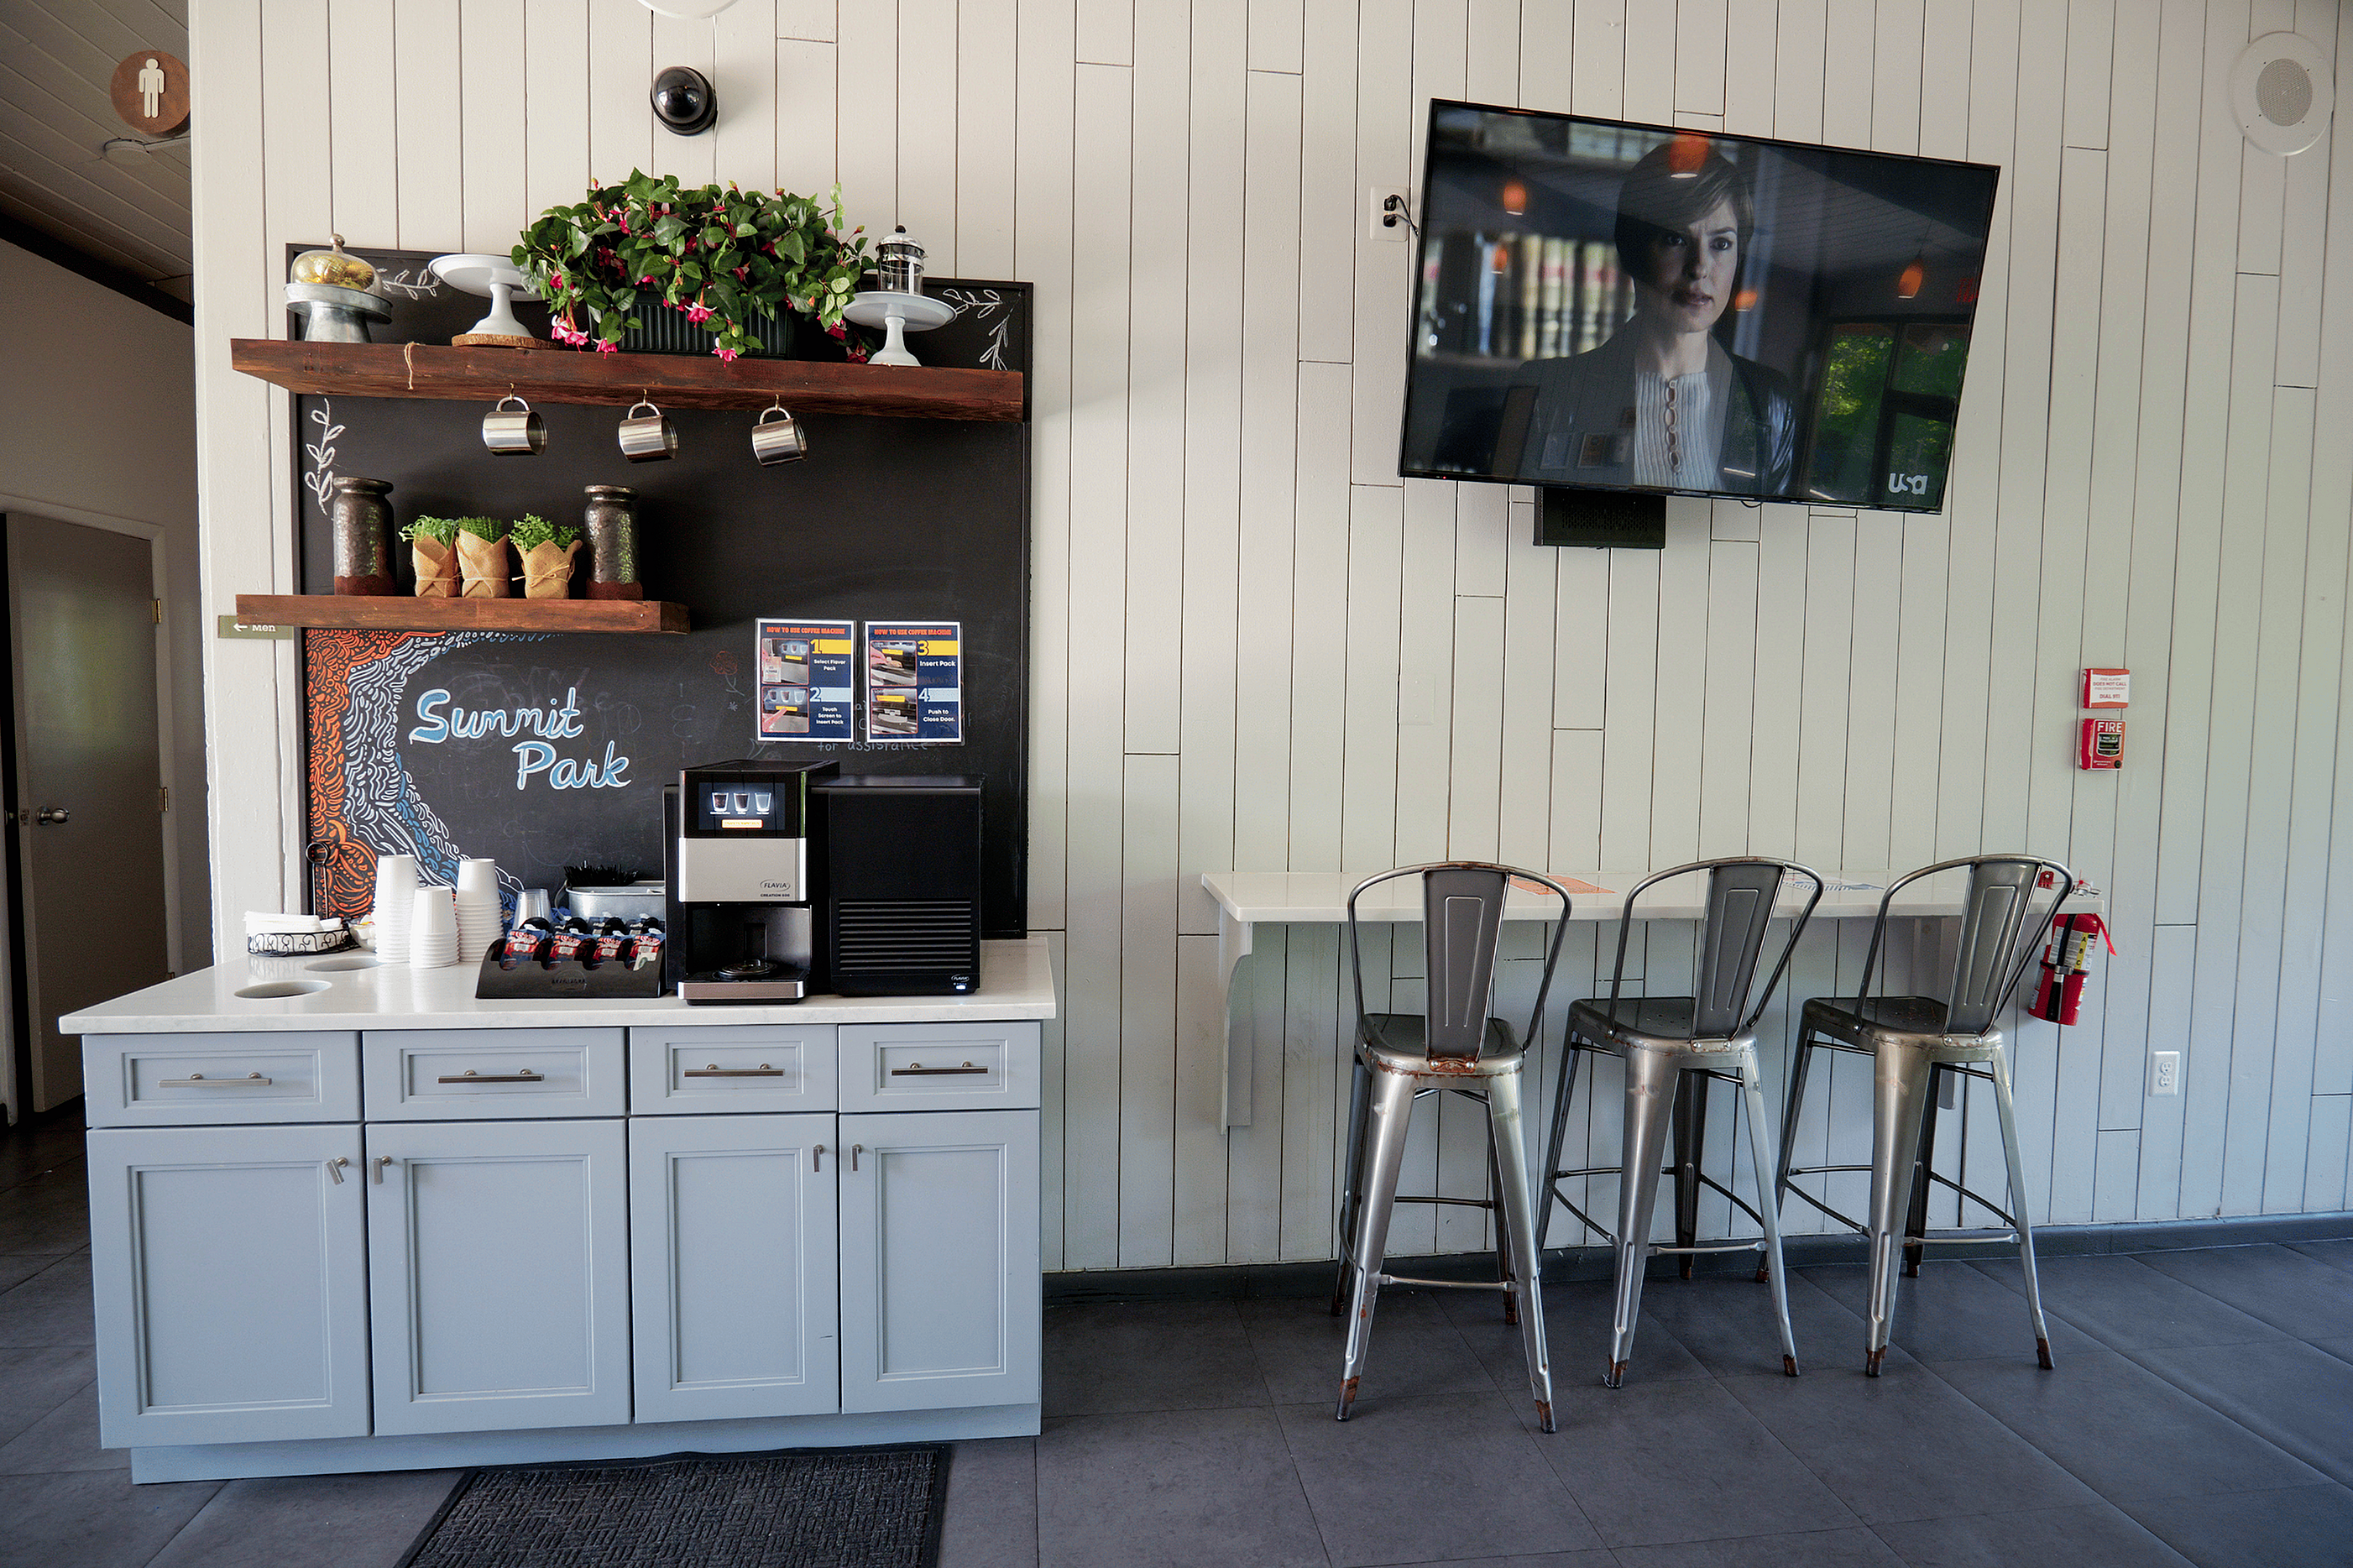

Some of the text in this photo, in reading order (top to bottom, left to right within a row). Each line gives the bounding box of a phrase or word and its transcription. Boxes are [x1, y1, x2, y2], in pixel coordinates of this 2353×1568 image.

[810, 639, 823, 654] 1
[918, 640, 928, 656] 3
[809, 687, 821, 702] 2
[918, 688, 930, 702] 4
[409, 687, 583, 744] Summit
[2097, 722, 2123, 733] FIRE
[511, 740, 631, 791] Park
